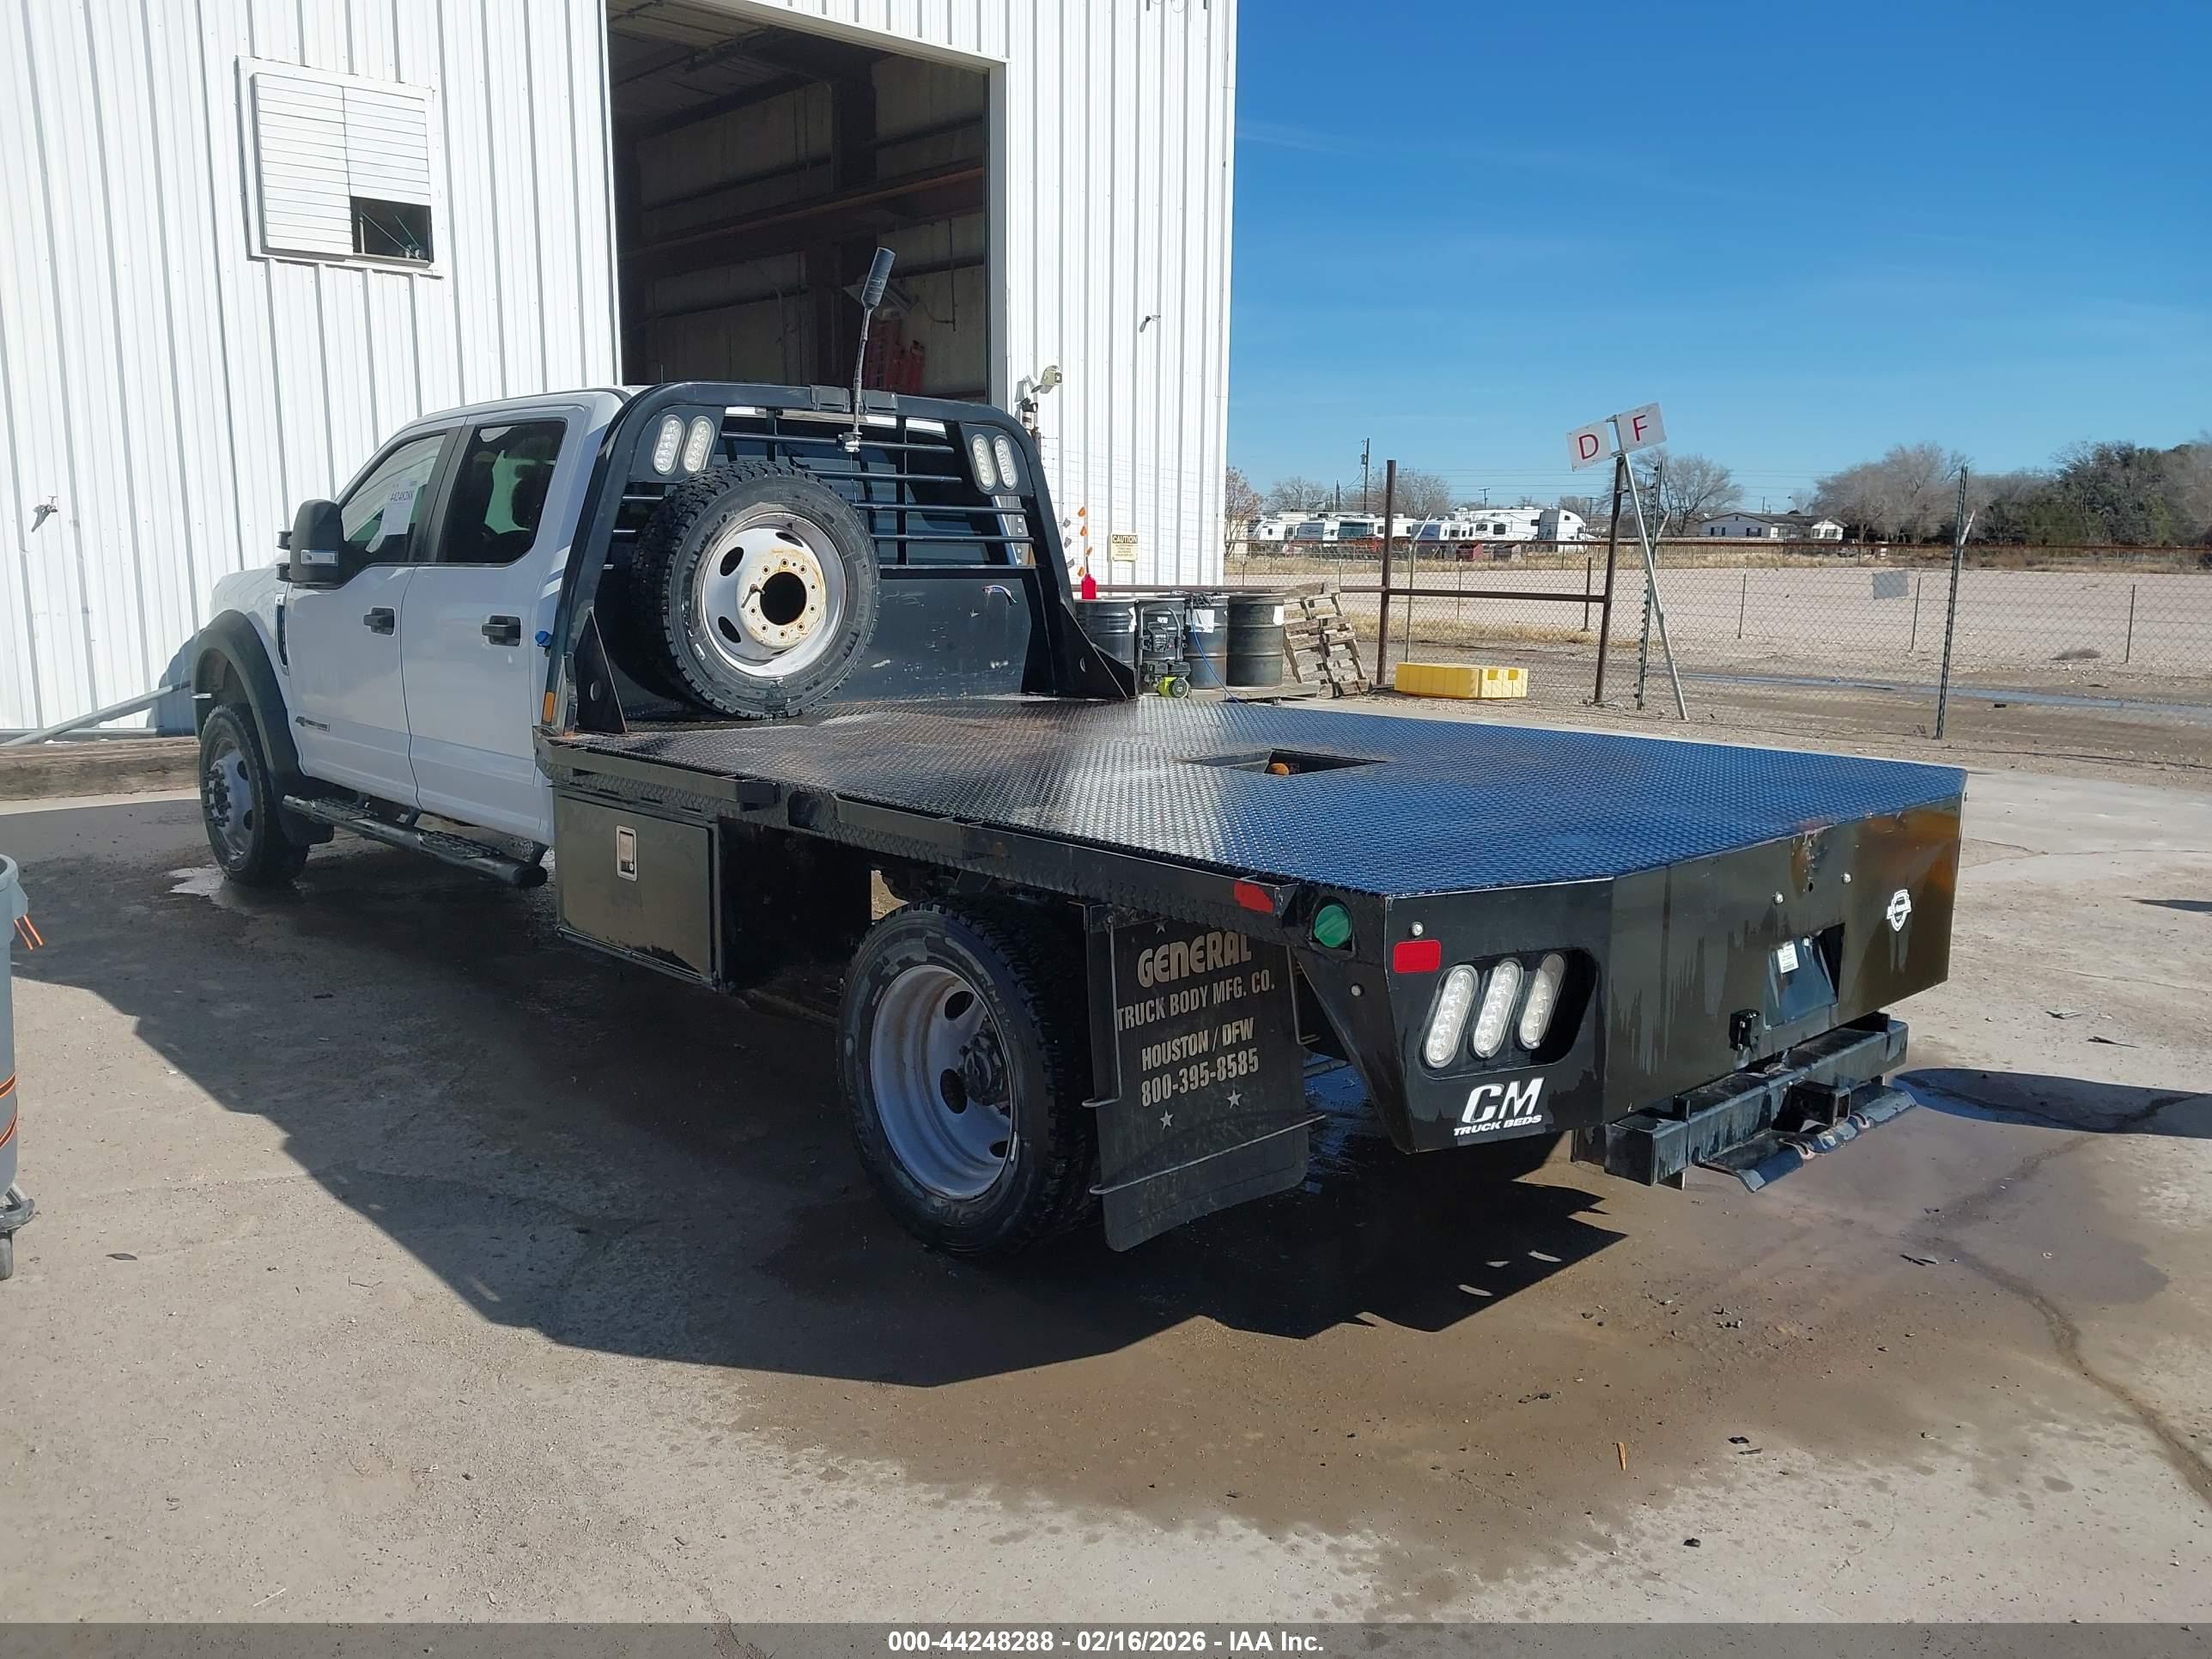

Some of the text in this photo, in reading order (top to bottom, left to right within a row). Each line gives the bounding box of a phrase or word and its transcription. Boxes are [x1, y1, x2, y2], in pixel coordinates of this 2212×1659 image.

[1578, 434, 1599, 460] D
[1632, 415, 1648, 441] F
[1112, 535, 1138, 544] CAUTION
[1137, 931, 1252, 988] GENERAL
[1117, 969, 1275, 1031] TRUCK BODY MFG. CO.
[1141, 1017, 1255, 1072] HOUSTON / DFW
[1141, 1047, 1259, 1108] 800-395-8585
[1462, 1077, 1546, 1125] CM
[1453, 1114, 1543, 1137] TRUCK BEDS
